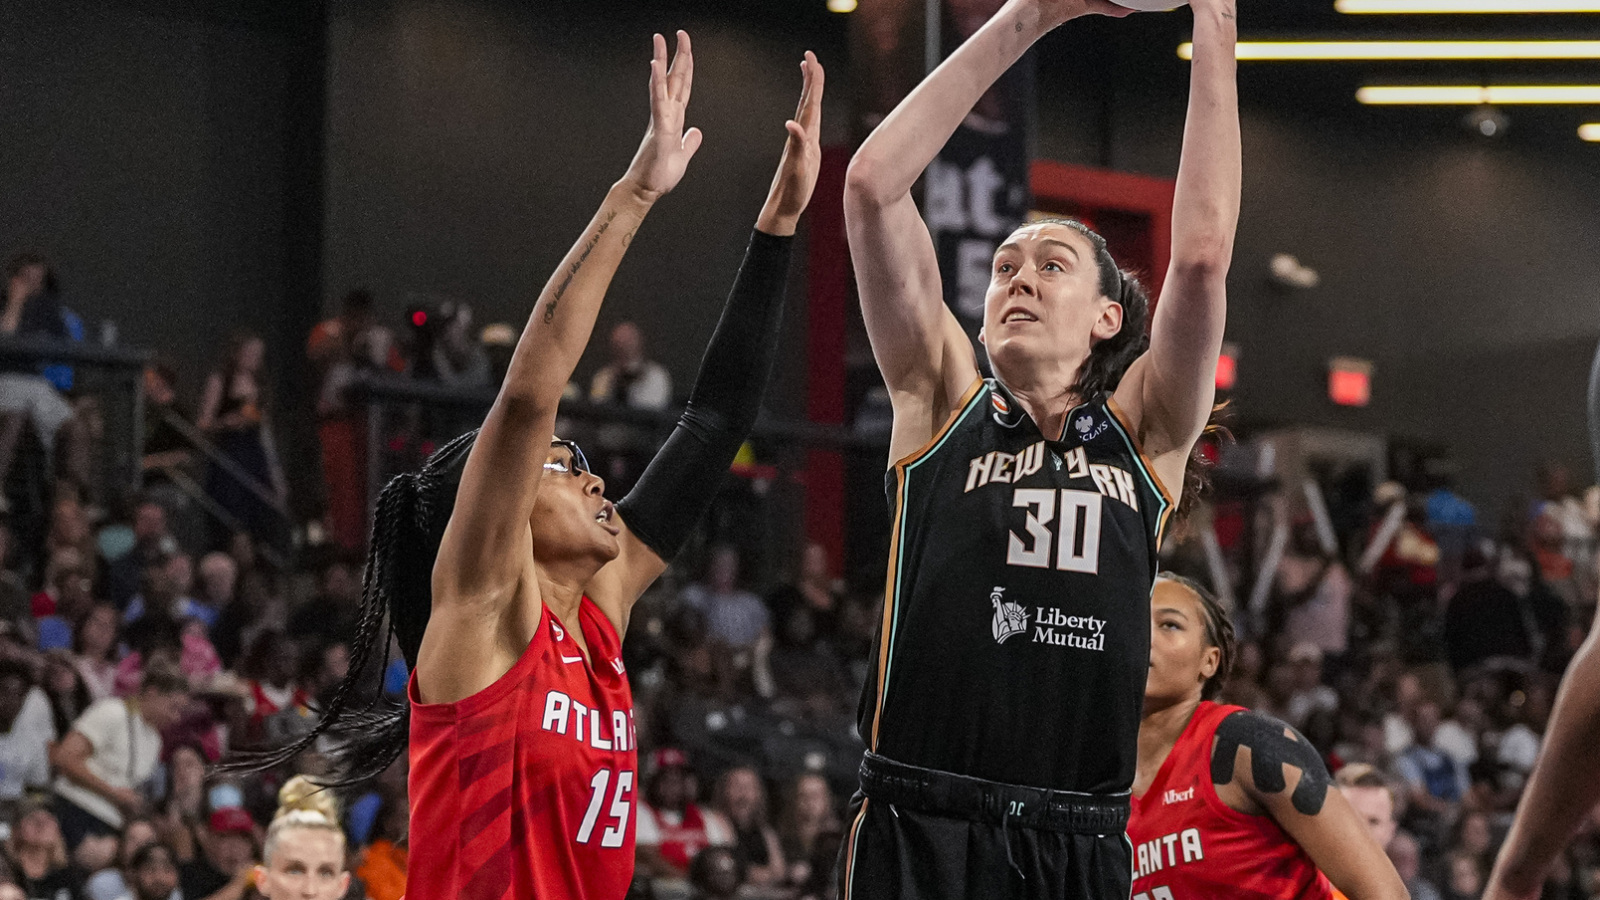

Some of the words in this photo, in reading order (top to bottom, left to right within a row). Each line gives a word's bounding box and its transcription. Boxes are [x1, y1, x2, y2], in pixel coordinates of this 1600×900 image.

[1079, 420, 1109, 442] CLAYS
[964, 440, 1046, 494] NEW
[1063, 445, 1139, 513] YRK
[1006, 487, 1103, 576] 30
[1035, 606, 1107, 634] Liberty
[1032, 625, 1105, 652] Mutual
[575, 767, 634, 849] 15
[1162, 786, 1195, 806] Albert
